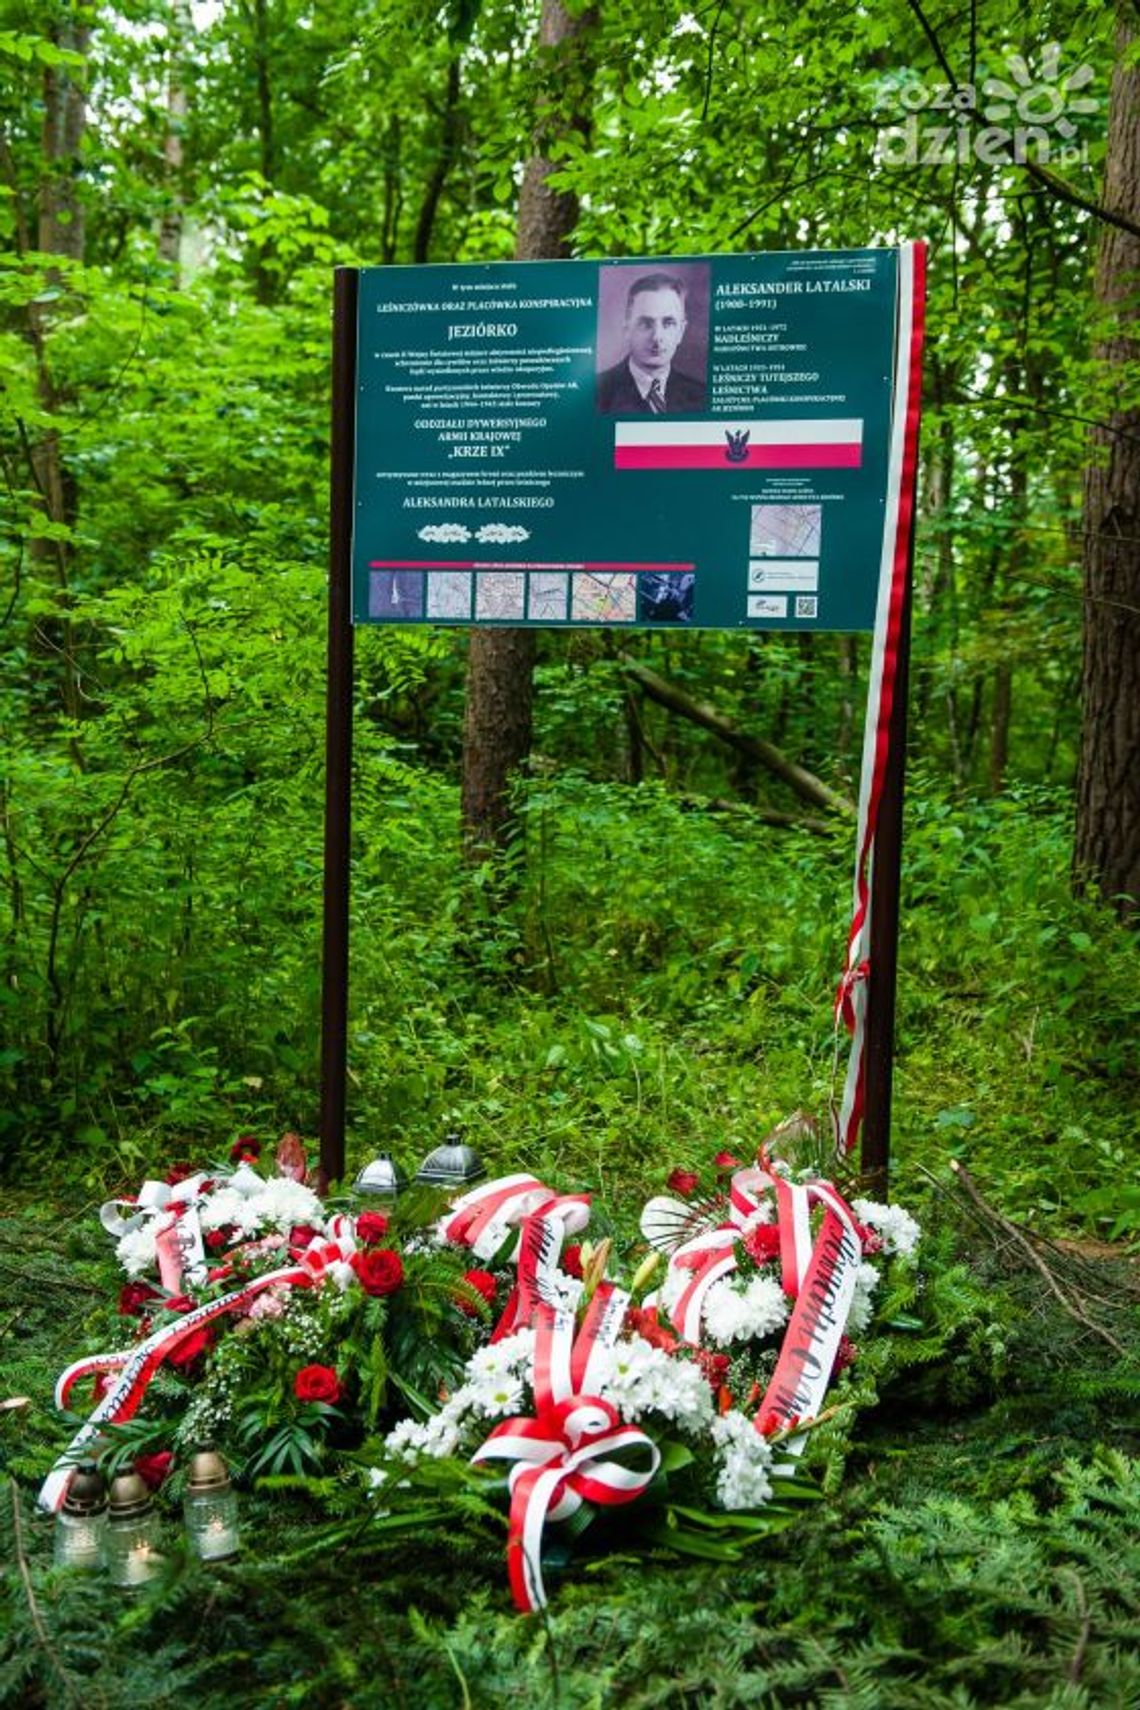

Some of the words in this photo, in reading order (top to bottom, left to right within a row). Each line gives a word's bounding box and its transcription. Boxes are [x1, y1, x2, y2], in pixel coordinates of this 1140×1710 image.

[716, 282, 803, 296] ALEKSANDER
[806, 279, 871, 293] LATALSKI
[377, 303, 440, 313] LEŚNICZÓWKA
[442, 302, 466, 311] ORAZ
[467, 299, 518, 310] PLACÓWKA
[519, 297, 593, 309] KONSPIRACYJNA
[447, 323, 518, 341] JEZIÓRKO
[714, 332, 779, 343] NADLEŚNICZY
[712, 374, 757, 384] LEŚNICZY
[760, 372, 820, 383] TUTEJSZEGO
[712, 386, 768, 394] LEŚNICTWA
[414, 420, 465, 428] ODDZIAŁU
[467, 418, 546, 429] DYWERSYJNEGO
[438, 432, 468, 441] ARMII
[470, 432, 521, 442] KRAJOWEJ
[402, 496, 476, 508] ALEKSANDRA
[478, 496, 554, 508] LATALSKIEGO
